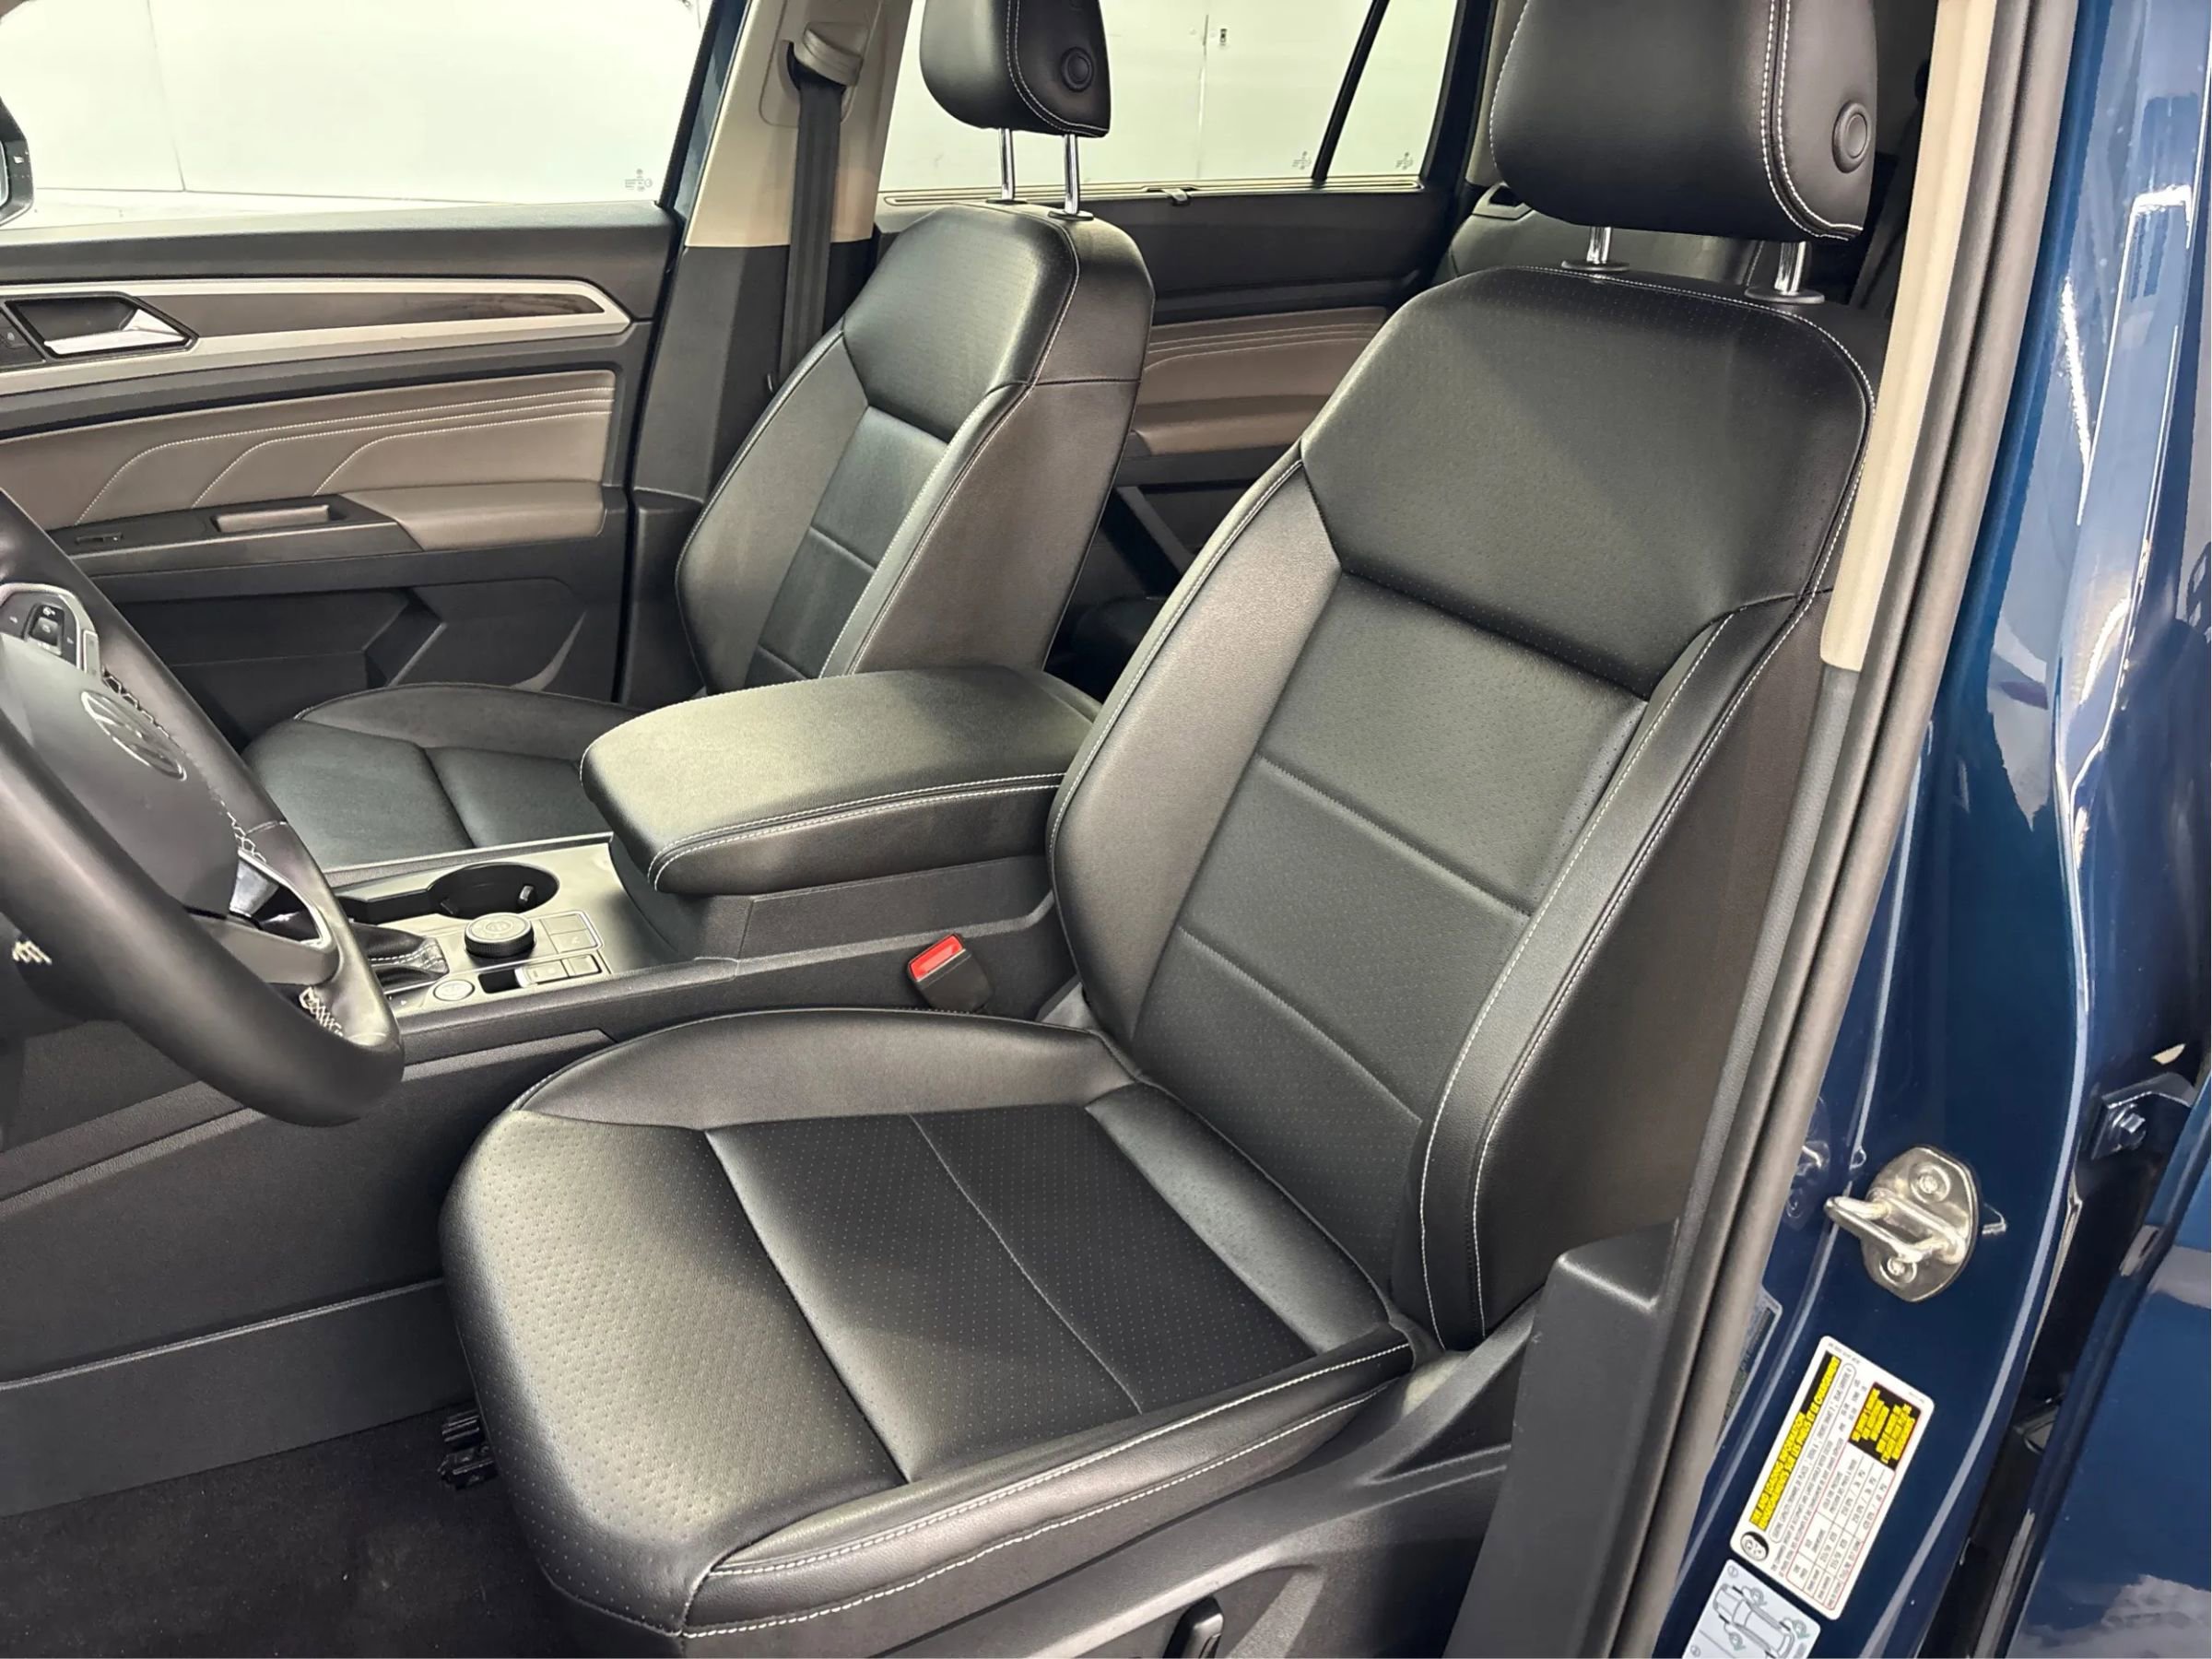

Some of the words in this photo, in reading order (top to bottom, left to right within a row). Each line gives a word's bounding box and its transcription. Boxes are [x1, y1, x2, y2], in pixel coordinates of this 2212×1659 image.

[1813, 1355, 1841, 1405] CHARGEMENT
[1756, 1492, 1770, 1511] AND
[1763, 1460, 1784, 1495] LOADING
[1778, 1410, 1806, 1463] INFORMATION
